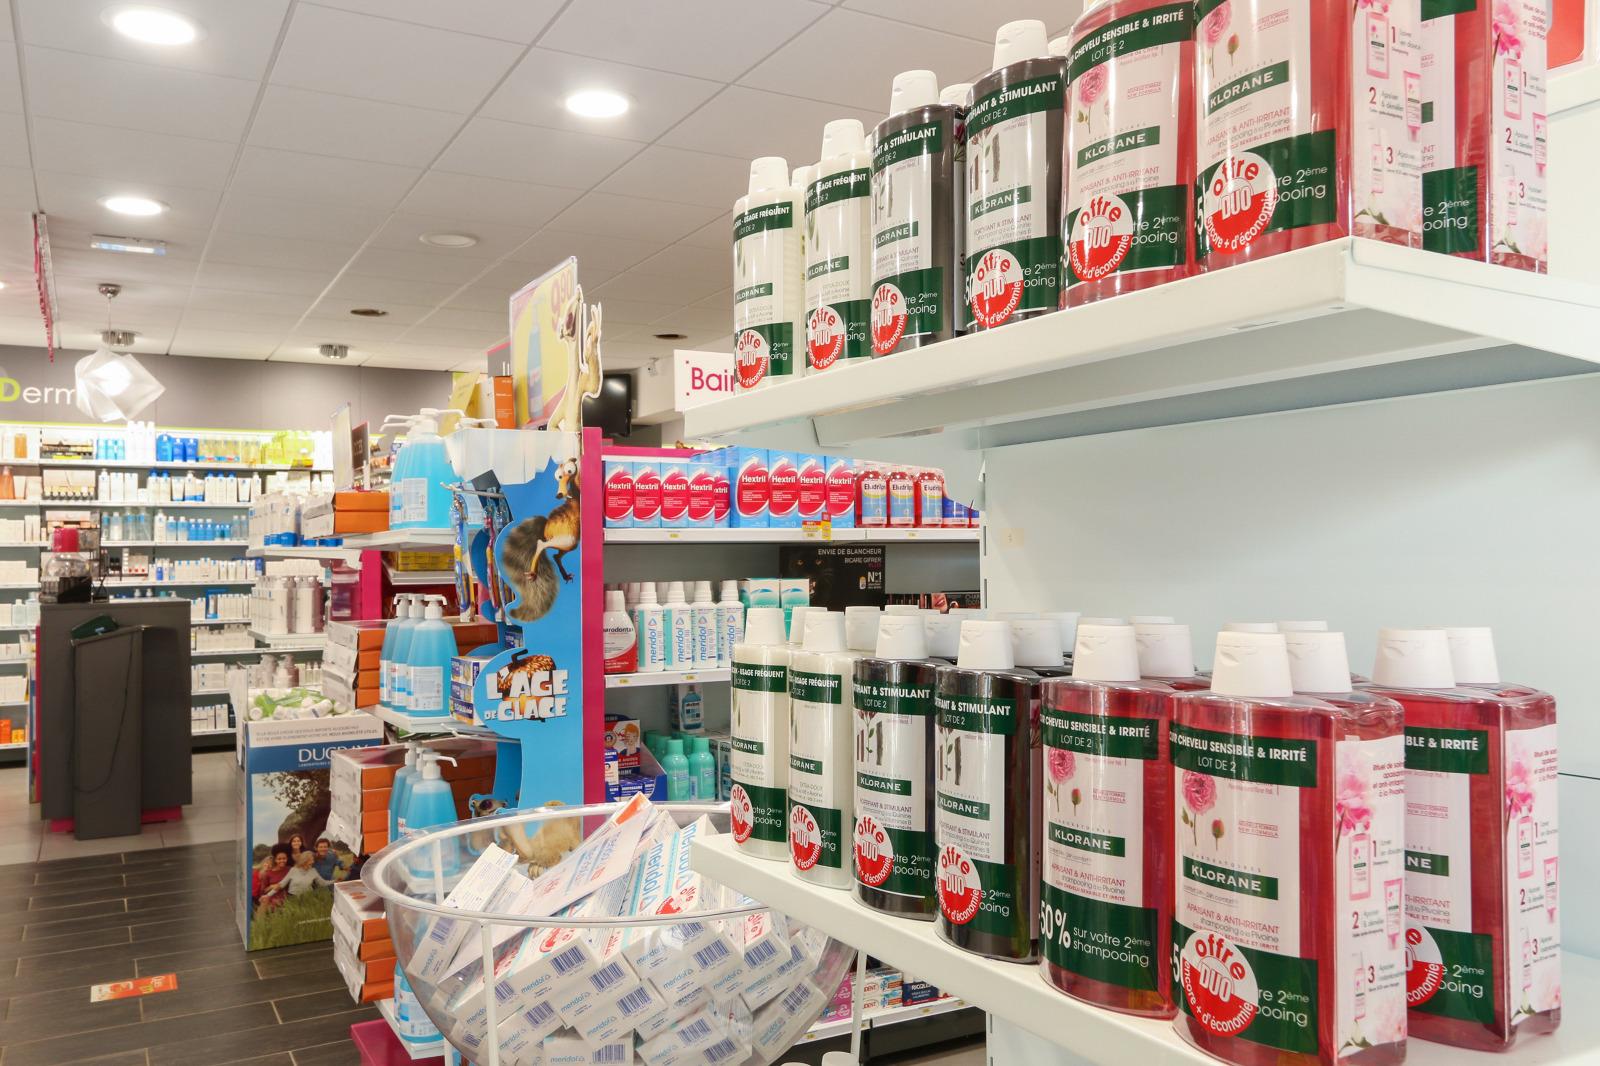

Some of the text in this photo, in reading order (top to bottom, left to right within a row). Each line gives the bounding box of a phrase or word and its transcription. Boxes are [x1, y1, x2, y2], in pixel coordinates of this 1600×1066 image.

[1074, 36, 1101, 60] CHEVELU
[1101, 20, 1139, 43] SENSIBLE
[1142, 16, 1150, 28] &
[1152, 9, 1184, 26] IRRITÉ
[1391, 26, 1396, 44] 1
[1091, 49, 1104, 62] LOT
[1106, 44, 1117, 57] DE
[1119, 40, 1125, 51] 2
[1522, 71, 1528, 88] 1
[990, 81, 1057, 108] & STIMULANT
[1210, 71, 1274, 109] KLORANE
[1369, 86, 1377, 105] 2
[992, 106, 1008, 120] DE 2
[889, 127, 937, 148] STIMULANT
[1505, 127, 1513, 145] 2
[1084, 133, 1146, 161] KLORANE
[1386, 147, 1394, 164] 3
[833, 173, 867, 186] FRÉQUENT
[1213, 155, 1259, 197] offre
[1296, 165, 1328, 184] 2ème
[1519, 182, 1526, 199] 3
[759, 206, 790, 218] FRÉQUENT
[974, 191, 1020, 214] KLORANE
[1080, 197, 1121, 226] offre
[1221, 186, 1251, 221] DUO
[1438, 199, 1470, 216] 2ème
[1153, 215, 1180, 229] 2ème
[1205, 188, 1277, 250] encore d'économie
[1086, 225, 1112, 249] DUO
[1071, 234, 1130, 279] encore d'économie
[1034, 263, 1057, 275] 2ème
[989, 281, 1021, 325] d'économie
[811, 306, 836, 330] offre
[739, 330, 761, 352] offre
[607, 482, 631, 490] Hextril
[635, 482, 659, 490] Hextril
[663, 482, 686, 491] Hextril
[690, 483, 713, 491] Hextril
[741, 475, 766, 483] Hextril
[771, 475, 796, 483] Hextril
[800, 475, 823, 484] Hextril
[829, 476, 852, 485] Hextril
[648, 628, 658, 664] meridol
[676, 627, 685, 663] meridol
[699, 626, 707, 662] meridol
[754, 669, 785, 679] FRÉQUENT
[808, 677, 839, 688] FRÉQUENT
[872, 686, 931, 699] & STIMULANT
[484, 697, 568, 722] DE GLACE
[873, 700, 887, 709] DE 2
[951, 701, 1011, 716] & STIMULANT
[952, 715, 966, 726] DE 2
[1045, 716, 1150, 738] CHEVELU SENSIBLE & IRRITÉ
[1060, 734, 1093, 748] LOT DE 2
[1177, 734, 1307, 763] CHEVELU SENSIBLE & IRRITÉ
[1406, 736, 1479, 751] BLE & IRRITÉ
[1198, 756, 1237, 772] LOT DE 2
[860, 776, 901, 791] KLORANE
[939, 799, 980, 815] KLORANE
[793, 808, 815, 833] offre
[858, 816, 885, 844] offre
[1054, 828, 1112, 851] KLORANE
[1373, 840, 1377, 858] 1
[864, 856, 892, 883] d'économie
[911, 855, 931, 865] 2ème
[941, 846, 971, 875] offre
[1407, 856, 1432, 869] NE
[944, 871, 966, 897] DUO
[1080, 871, 1127, 888] ANTI-IRRITANT
[1191, 864, 1262, 892] KLORANE
[989, 889, 1011, 900] 2ème
[1519, 888, 1526, 906] 2
[951, 889, 980, 921] d'économie
[1223, 914, 1280, 935] ANTI-IRRITANT
[1352, 911, 1359, 930] 2
[1073, 926, 1151, 949] sur votre 2ème
[1251, 931, 1280, 944] Pivoine
[1532, 938, 1538, 955] 3
[1073, 939, 1150, 968] shampooing
[1194, 933, 1246, 982] offre
[663, 969, 688, 990] meridol
[712, 969, 738, 990] meridol
[1368, 965, 1375, 983] 3
[1452, 964, 1485, 978] 2ème
[521, 975, 546, 994] meridol
[1199, 962, 1232, 1003] DUO
[561, 993, 585, 1013] meridol
[1183, 960, 1255, 1033] encore d'économie
[1278, 989, 1310, 1005] 2ème
[587, 1016, 612, 1037] meridol
[550, 1055, 577, 1063] meridol
